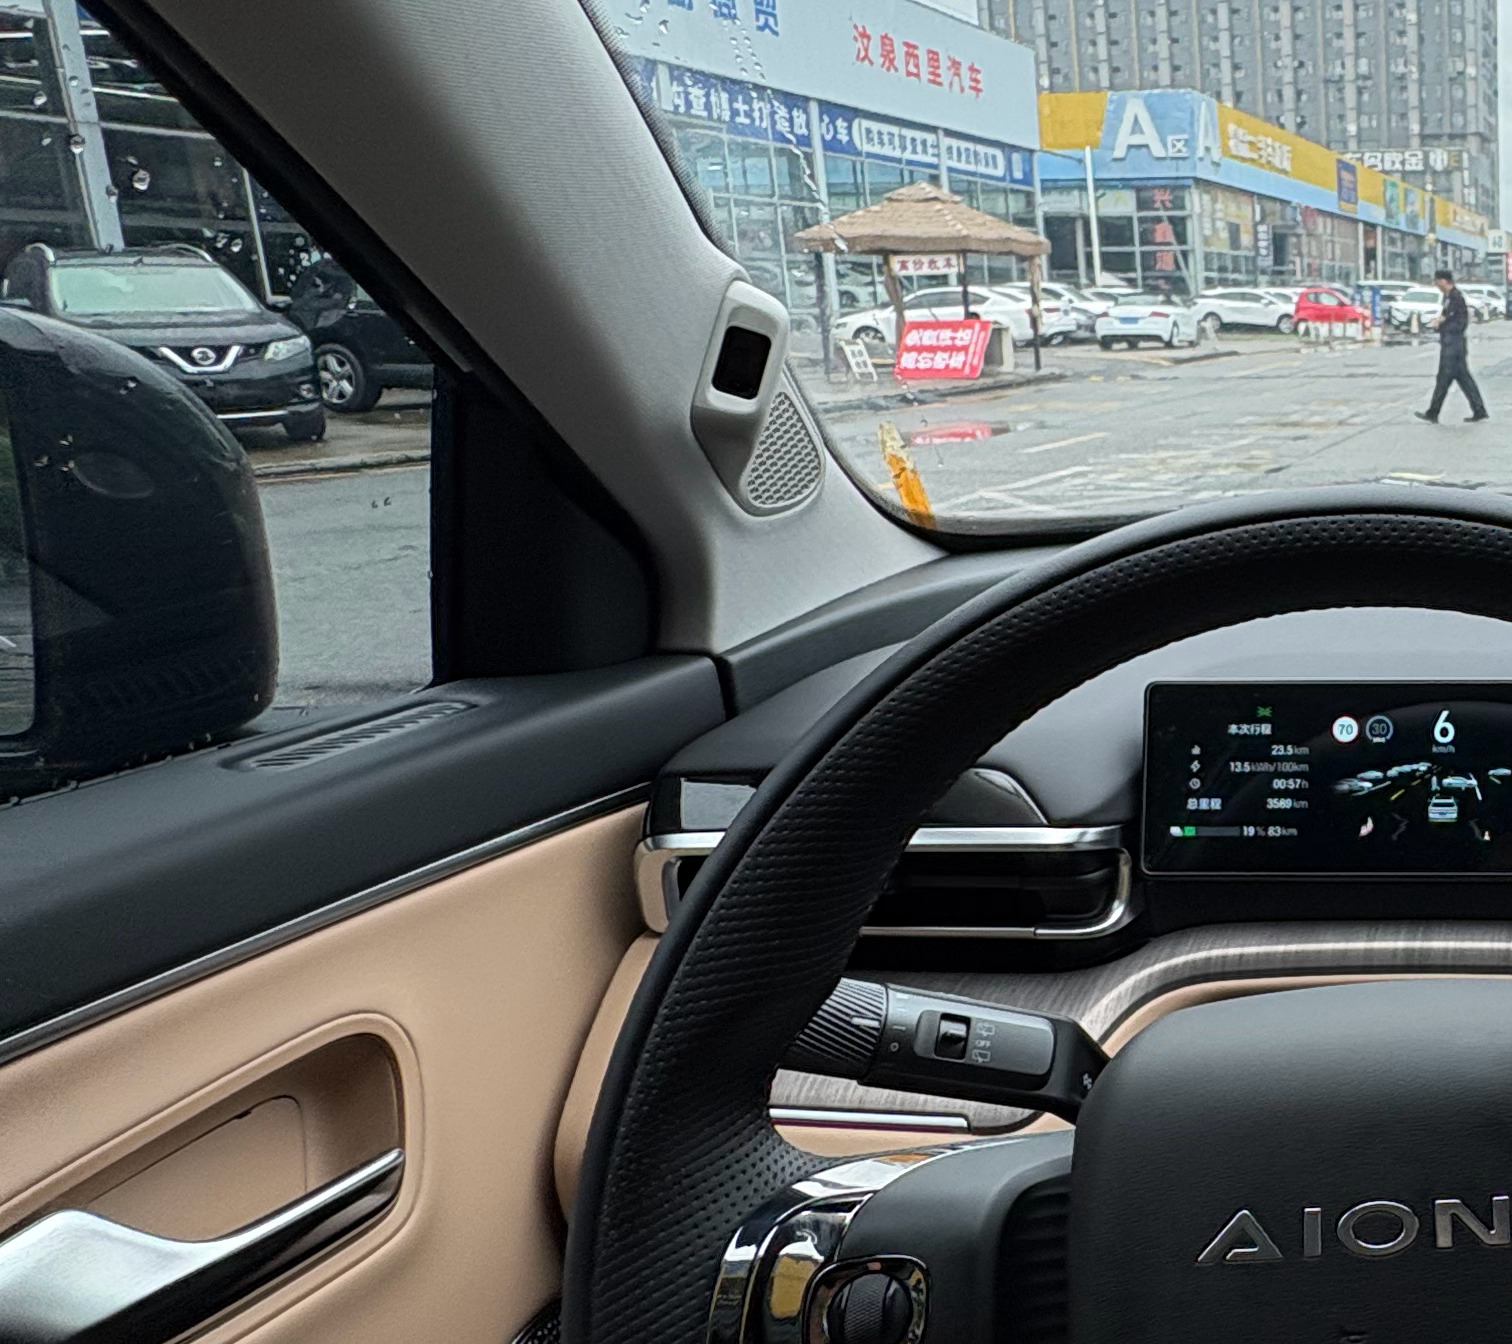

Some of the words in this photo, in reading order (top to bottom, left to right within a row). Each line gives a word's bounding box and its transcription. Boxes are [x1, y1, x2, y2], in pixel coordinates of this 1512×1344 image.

[1113, 97, 1168, 159] A
[1167, 134, 1190, 158] 区
[1338, 723, 1353, 736] 70
[1434, 710, 1455, 744] 6
[1195, 1196, 1511, 1265] AION
